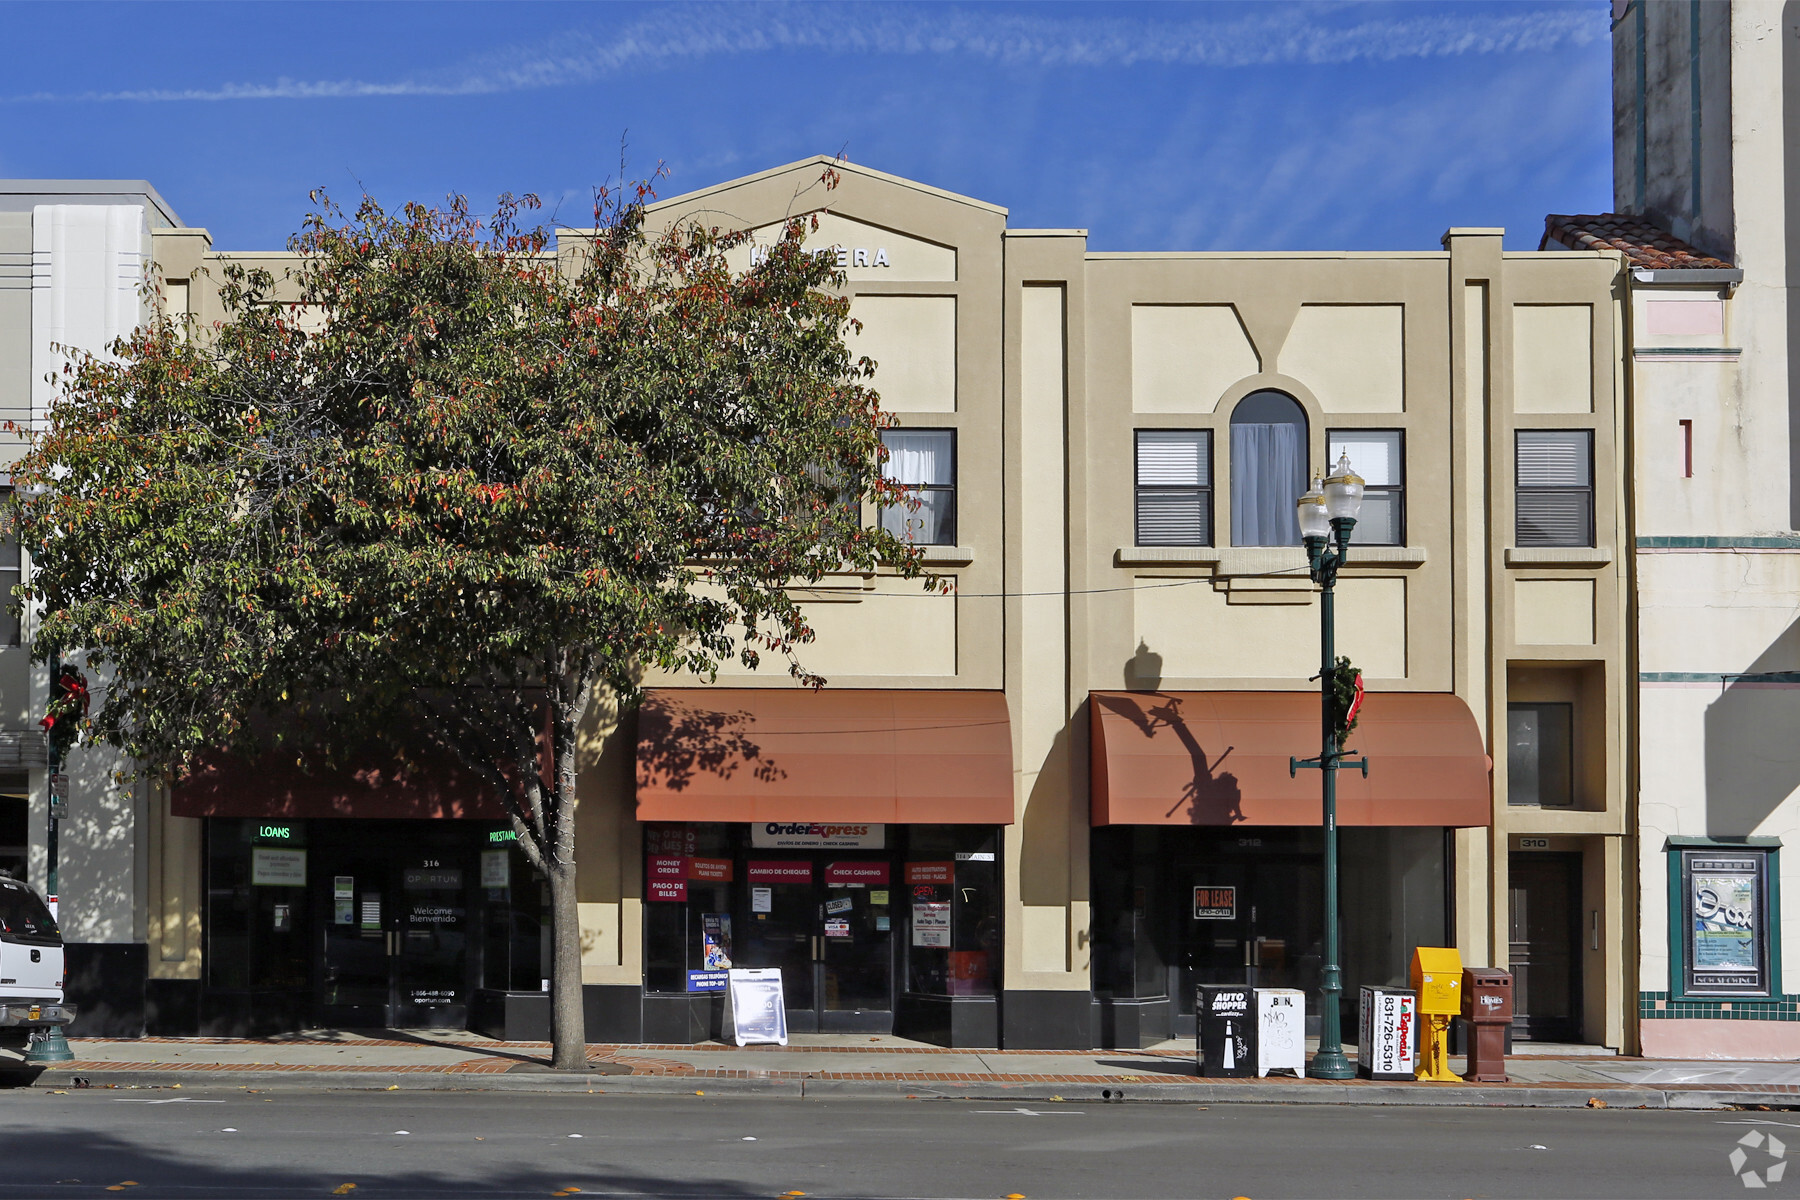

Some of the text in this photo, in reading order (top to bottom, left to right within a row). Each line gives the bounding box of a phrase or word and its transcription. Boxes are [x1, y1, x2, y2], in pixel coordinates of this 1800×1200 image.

[259, 825, 291, 839] LOANS
[766, 822, 868, 838] OrderExpress
[1522, 839, 1546, 847] 310
[423, 860, 440, 868] 316
[912, 886, 934, 896] OPEN
[1196, 890, 1233, 907] FOR LEASE
[826, 900, 843, 911] CLOSED
[413, 906, 453, 915] Welcome
[409, 915, 457, 923] Bienvenido
[414, 997, 451, 1005] oportun.com
[1214, 993, 1245, 1001] AUTO
[1211, 1001, 1247, 1010] SHOPPER
[1383, 997, 1394, 1071] 831-726-5310
